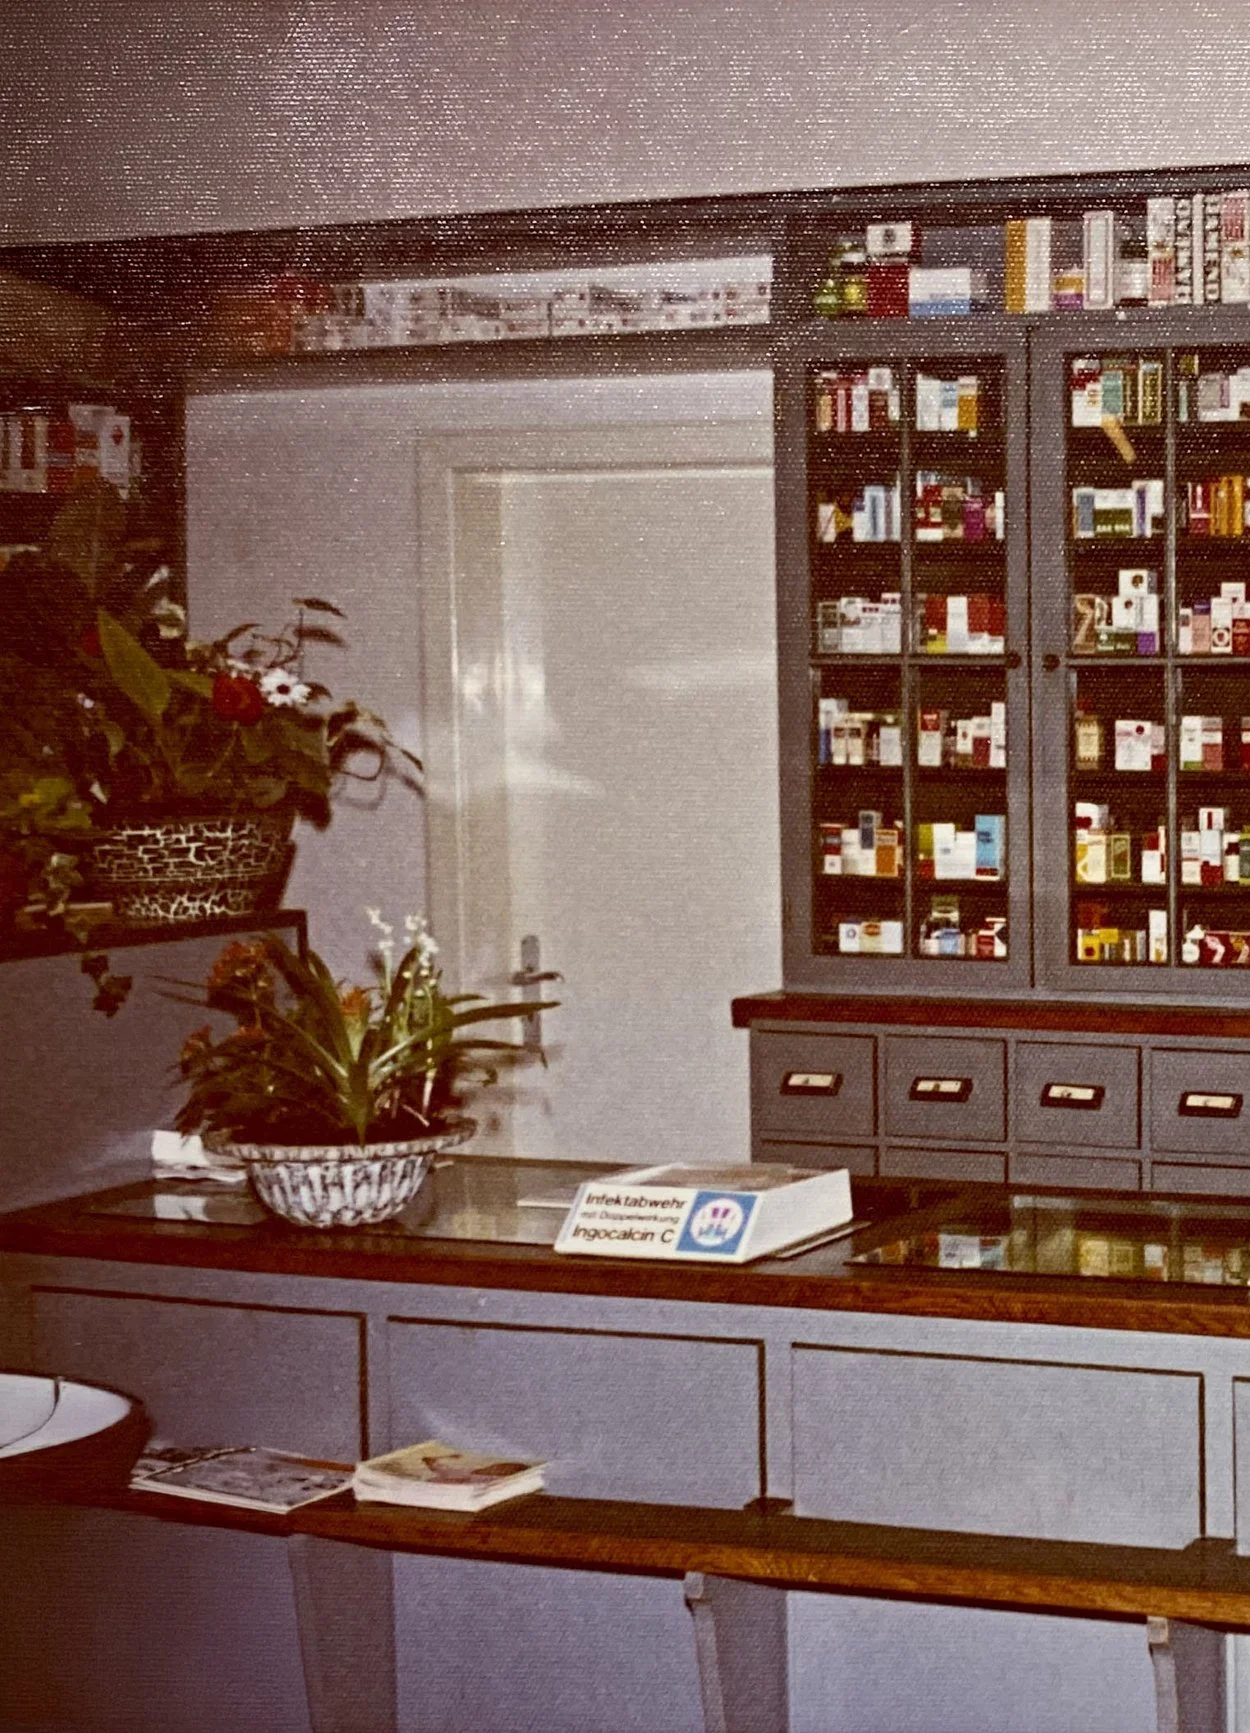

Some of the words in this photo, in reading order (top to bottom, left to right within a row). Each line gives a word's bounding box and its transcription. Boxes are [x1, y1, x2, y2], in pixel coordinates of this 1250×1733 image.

[586, 1194, 687, 1209] Infektabwehr
[573, 1224, 655, 1242] Ingocalcin
[661, 1229, 675, 1244] C
